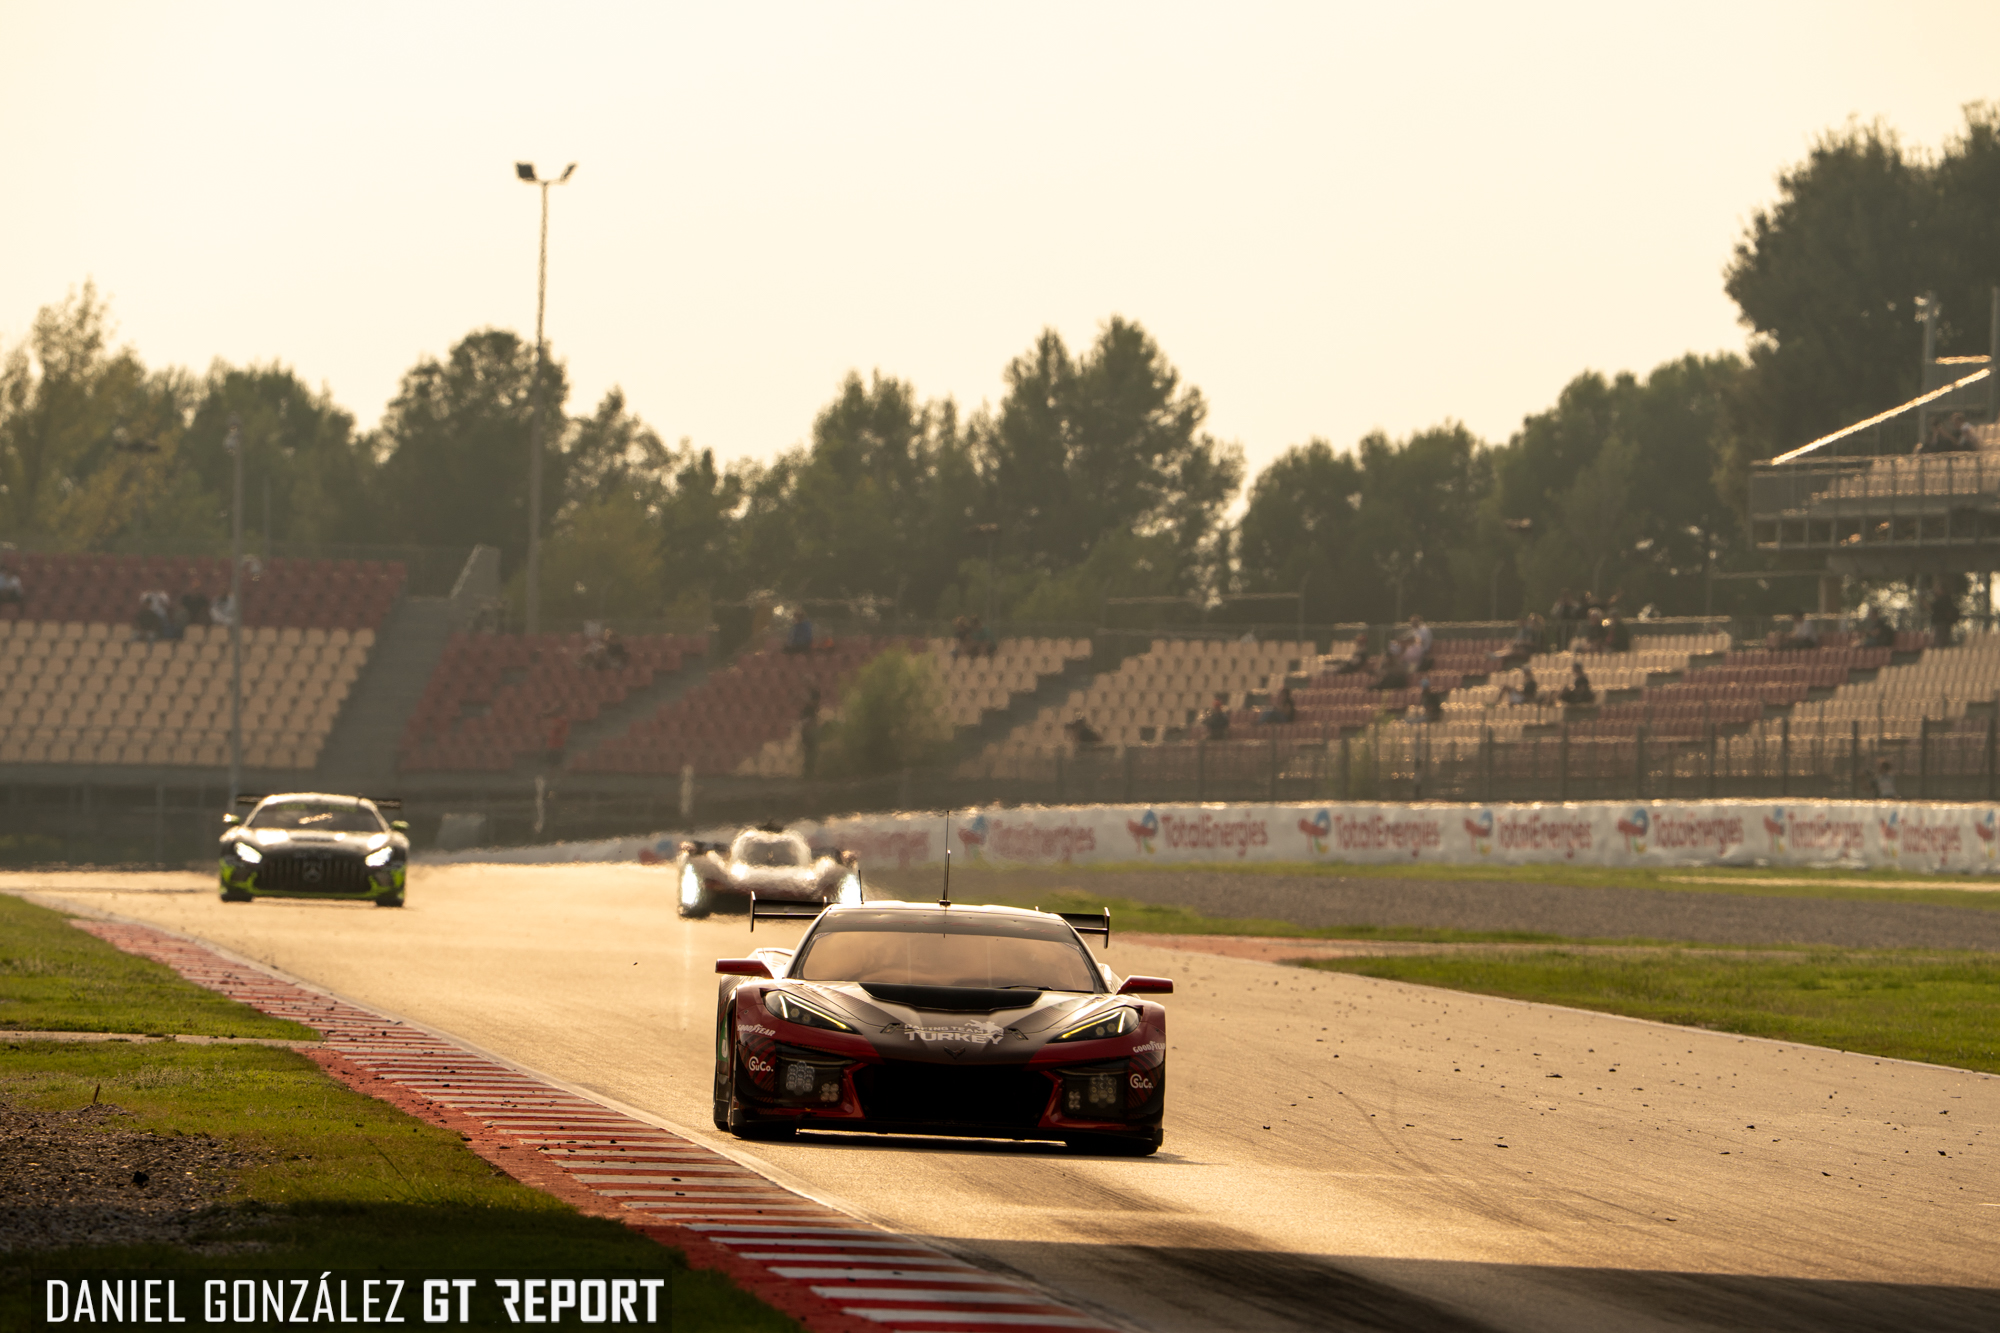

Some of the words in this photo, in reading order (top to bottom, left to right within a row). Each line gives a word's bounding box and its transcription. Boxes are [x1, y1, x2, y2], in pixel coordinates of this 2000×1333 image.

[1161, 812, 1268, 857] TotalEnergies
[1333, 812, 1440, 858] TotalEnergies
[737, 1023, 776, 1037] GOODYEAR
[904, 1023, 949, 1033] RACING
[951, 1026, 985, 1034] TEAM
[904, 1031, 1004, 1045] TURKEY
